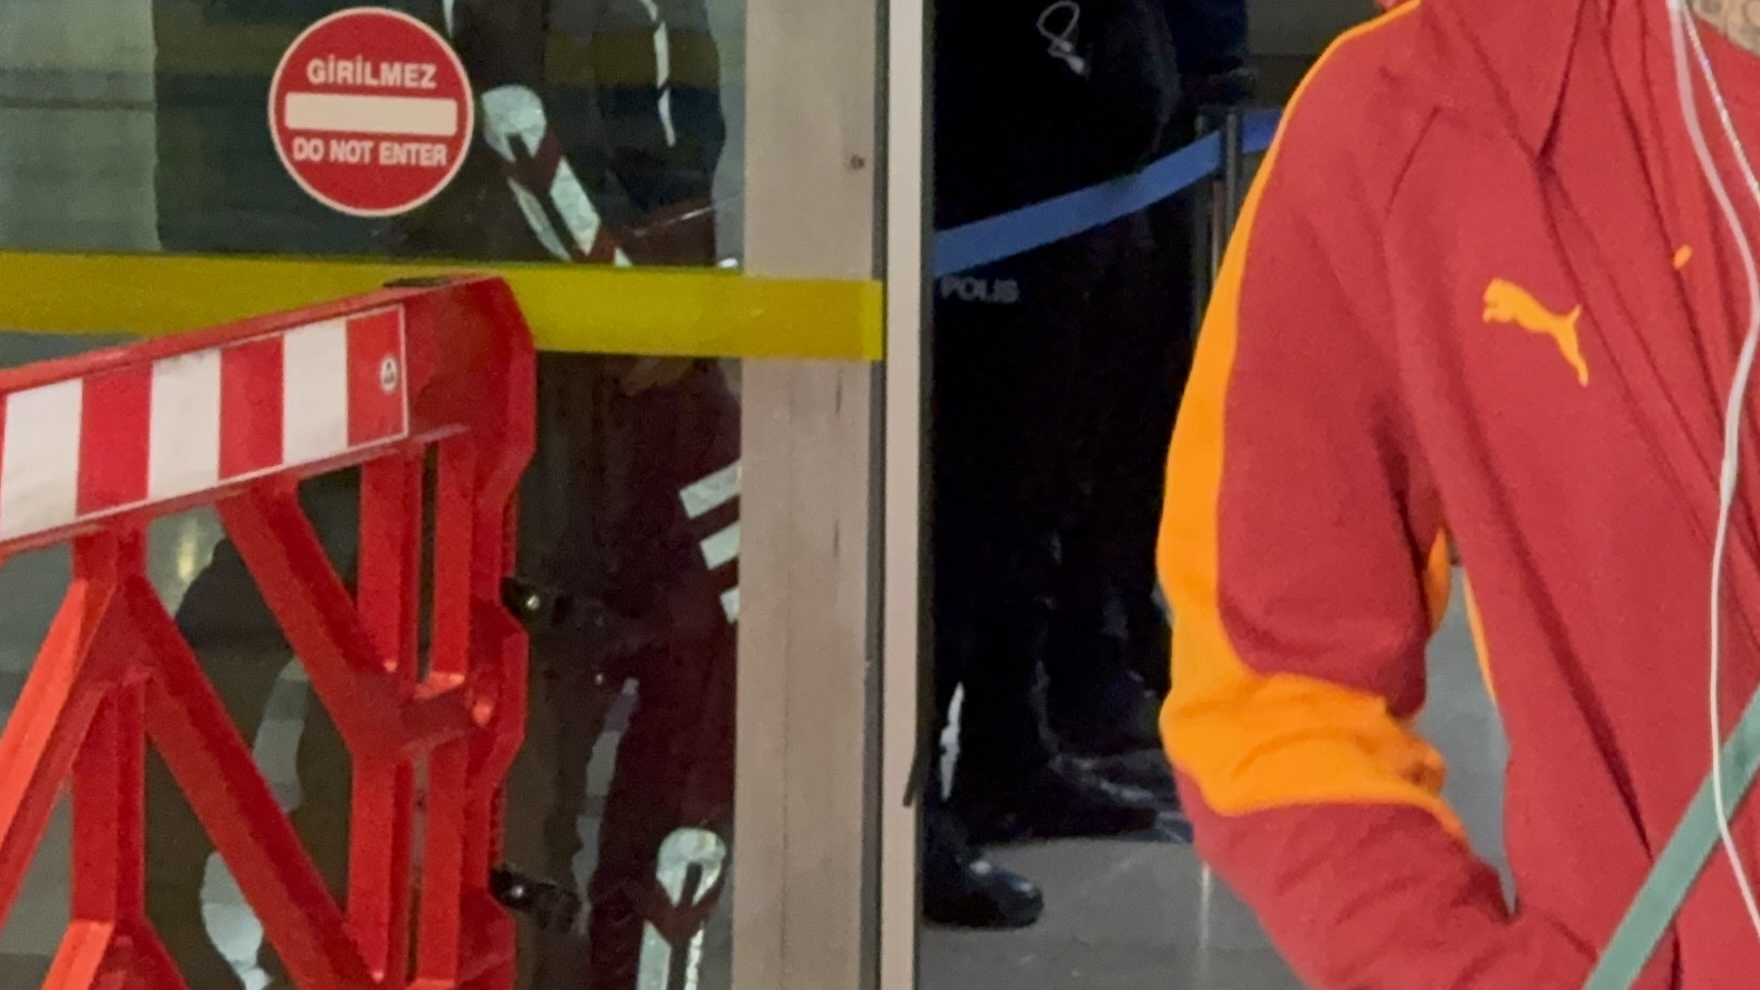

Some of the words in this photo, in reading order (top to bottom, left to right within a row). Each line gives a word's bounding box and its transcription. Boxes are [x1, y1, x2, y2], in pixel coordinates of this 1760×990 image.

[306, 53, 438, 90] GİRİLMEZ
[292, 136, 326, 162] DO
[329, 139, 375, 166] NOT
[378, 141, 448, 168] ENTER
